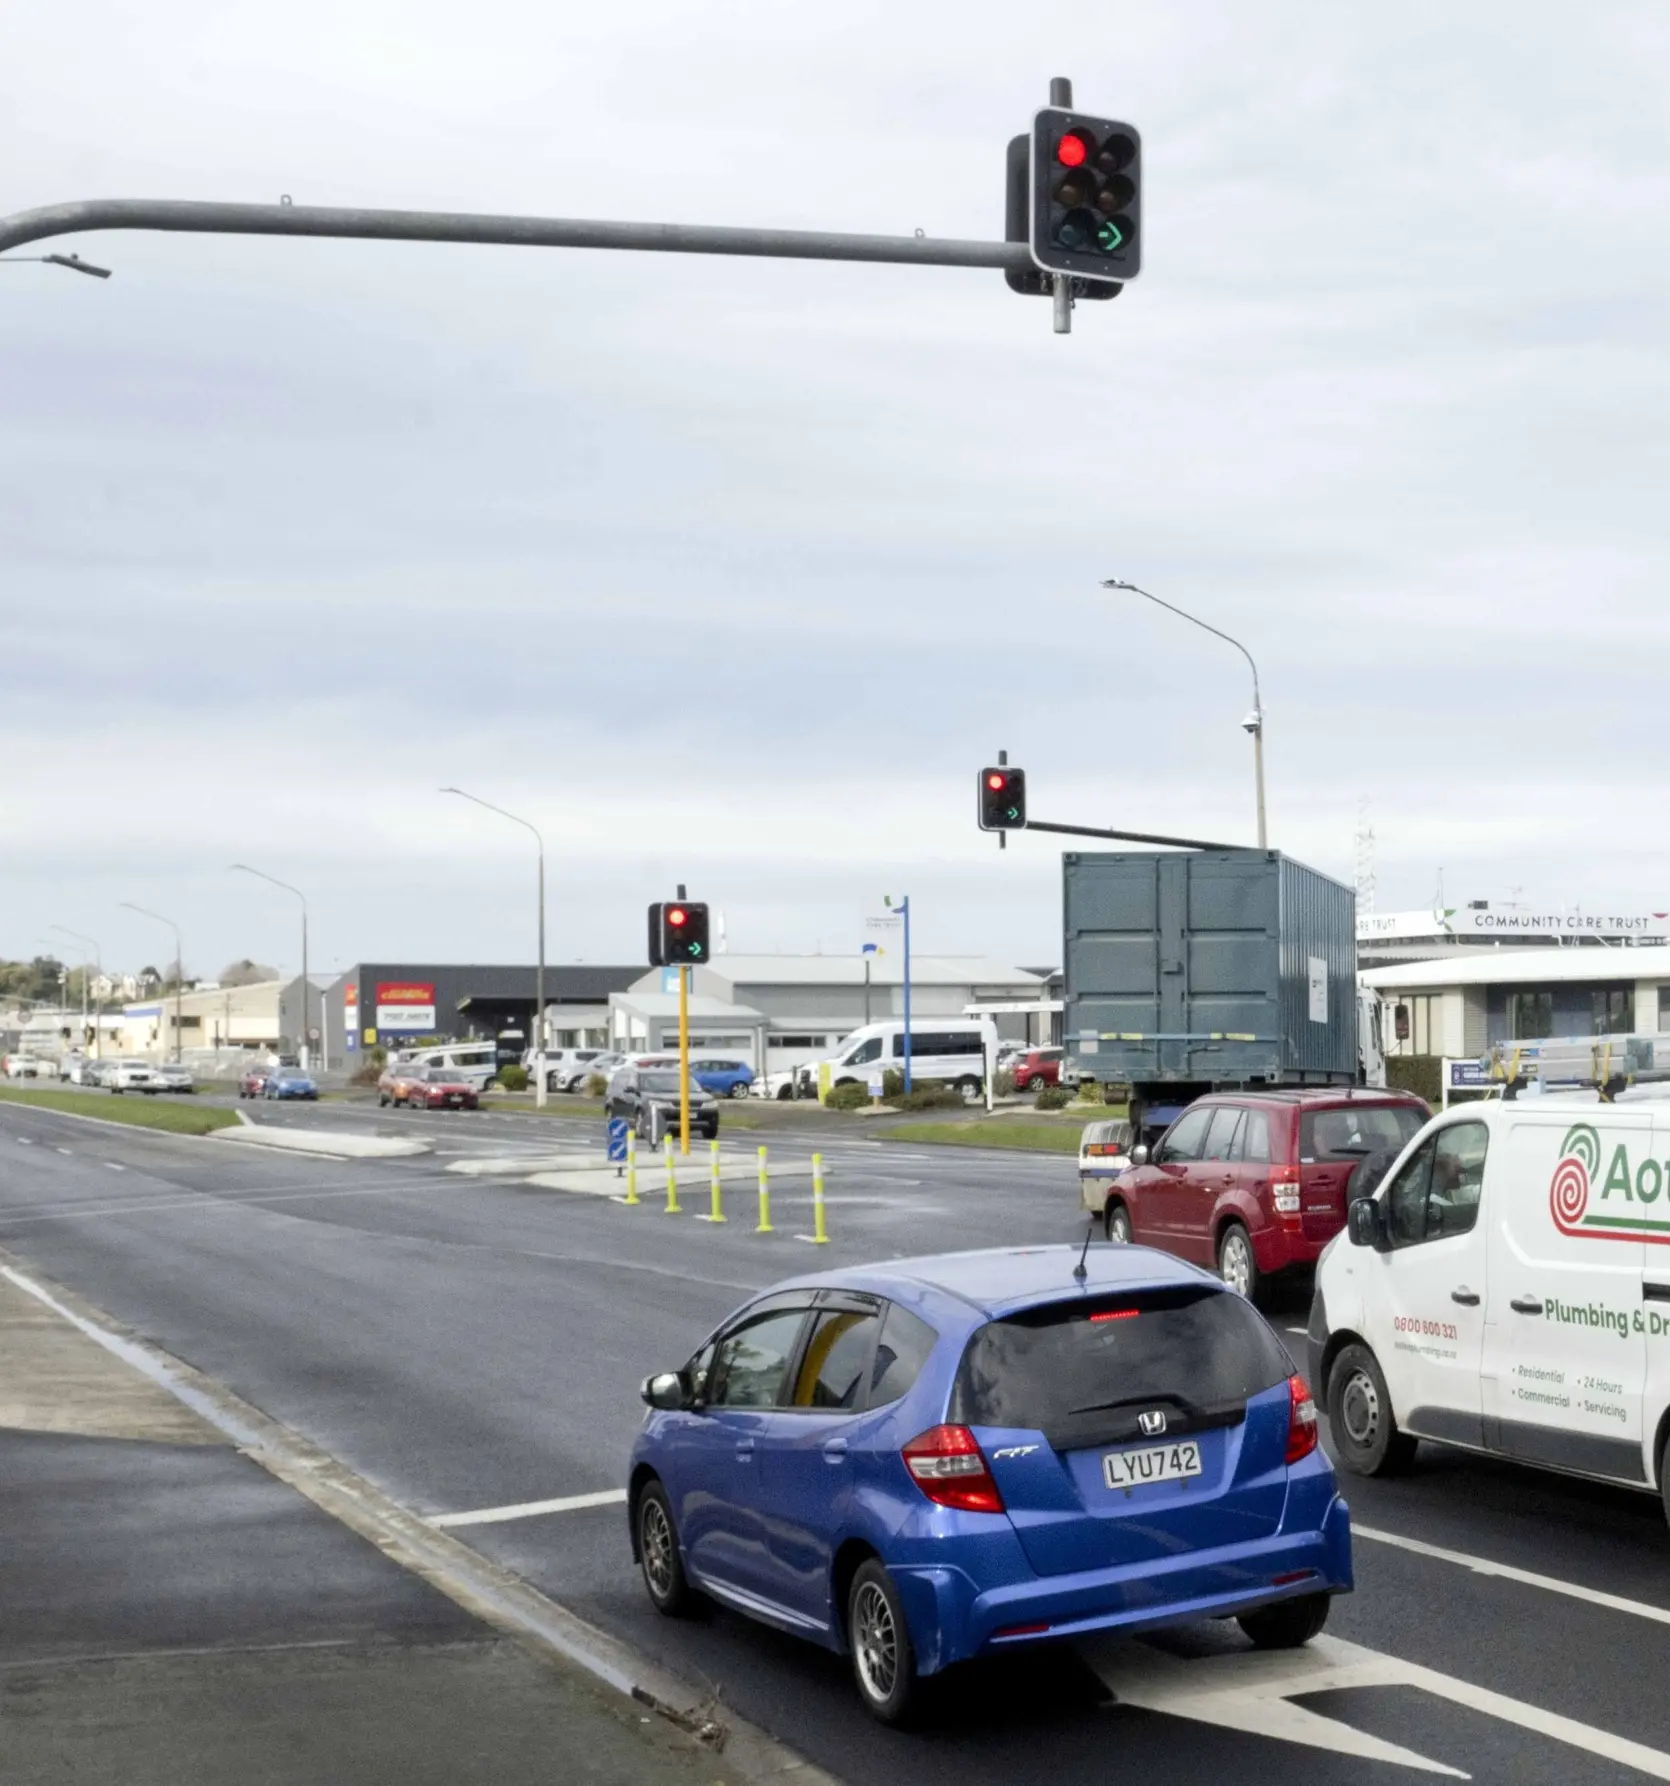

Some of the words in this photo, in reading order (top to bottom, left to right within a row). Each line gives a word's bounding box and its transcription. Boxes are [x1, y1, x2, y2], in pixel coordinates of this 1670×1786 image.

[1475, 915, 1562, 928] COMMUNITY
[1567, 916, 1602, 929] CARE
[1608, 917, 1649, 929] TRUST
[1394, 1315, 1421, 1334] 0800
[1441, 1323, 1458, 1341] 321
[1545, 1298, 1629, 1338] Plumbing
[1632, 1309, 1645, 1333] &
[1518, 1364, 1566, 1384] Residential
[1583, 1376, 1595, 1389] 24
[1595, 1379, 1623, 1395] Hours
[1517, 1387, 1571, 1408] Commercial
[1584, 1399, 1627, 1423] Servicing
[1107, 1446, 1198, 1483] LYU742
